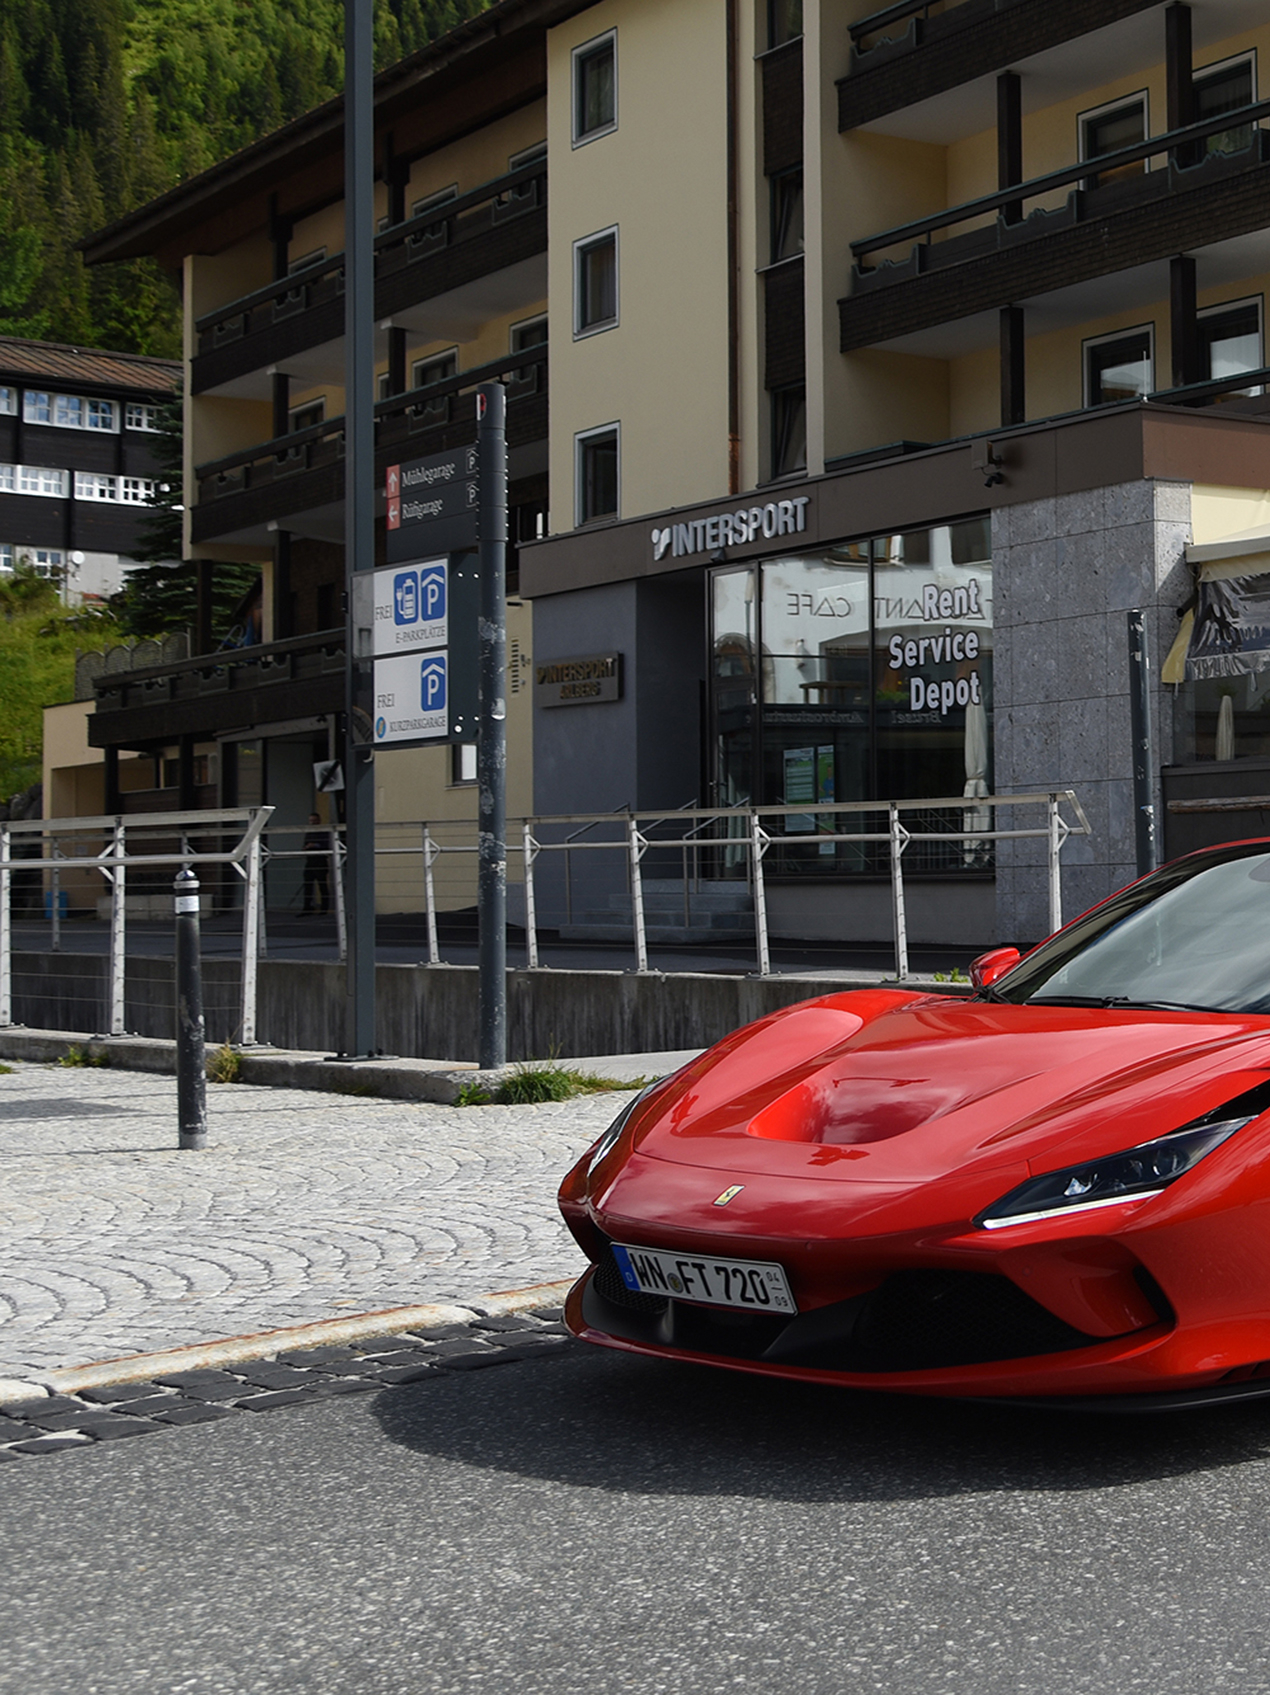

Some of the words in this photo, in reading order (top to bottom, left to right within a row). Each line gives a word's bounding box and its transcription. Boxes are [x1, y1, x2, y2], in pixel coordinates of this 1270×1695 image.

[402, 463, 455, 487] Mühlegarage
[672, 497, 809, 557] INTERSPORT
[375, 604, 393, 620] FREI
[923, 578, 980, 621] Rent
[395, 625, 445, 643] E-PARKPLÄTZE
[888, 627, 980, 669] Service
[546, 658, 616, 684] INTERSPORT
[377, 693, 395, 708] FREI
[560, 681, 601, 699] ARLBERG
[910, 671, 981, 715] Depot
[629, 1252, 669, 1291] WN
[675, 1260, 713, 1297] FT
[714, 1265, 770, 1305] 720
[766, 1271, 780, 1283] 04
